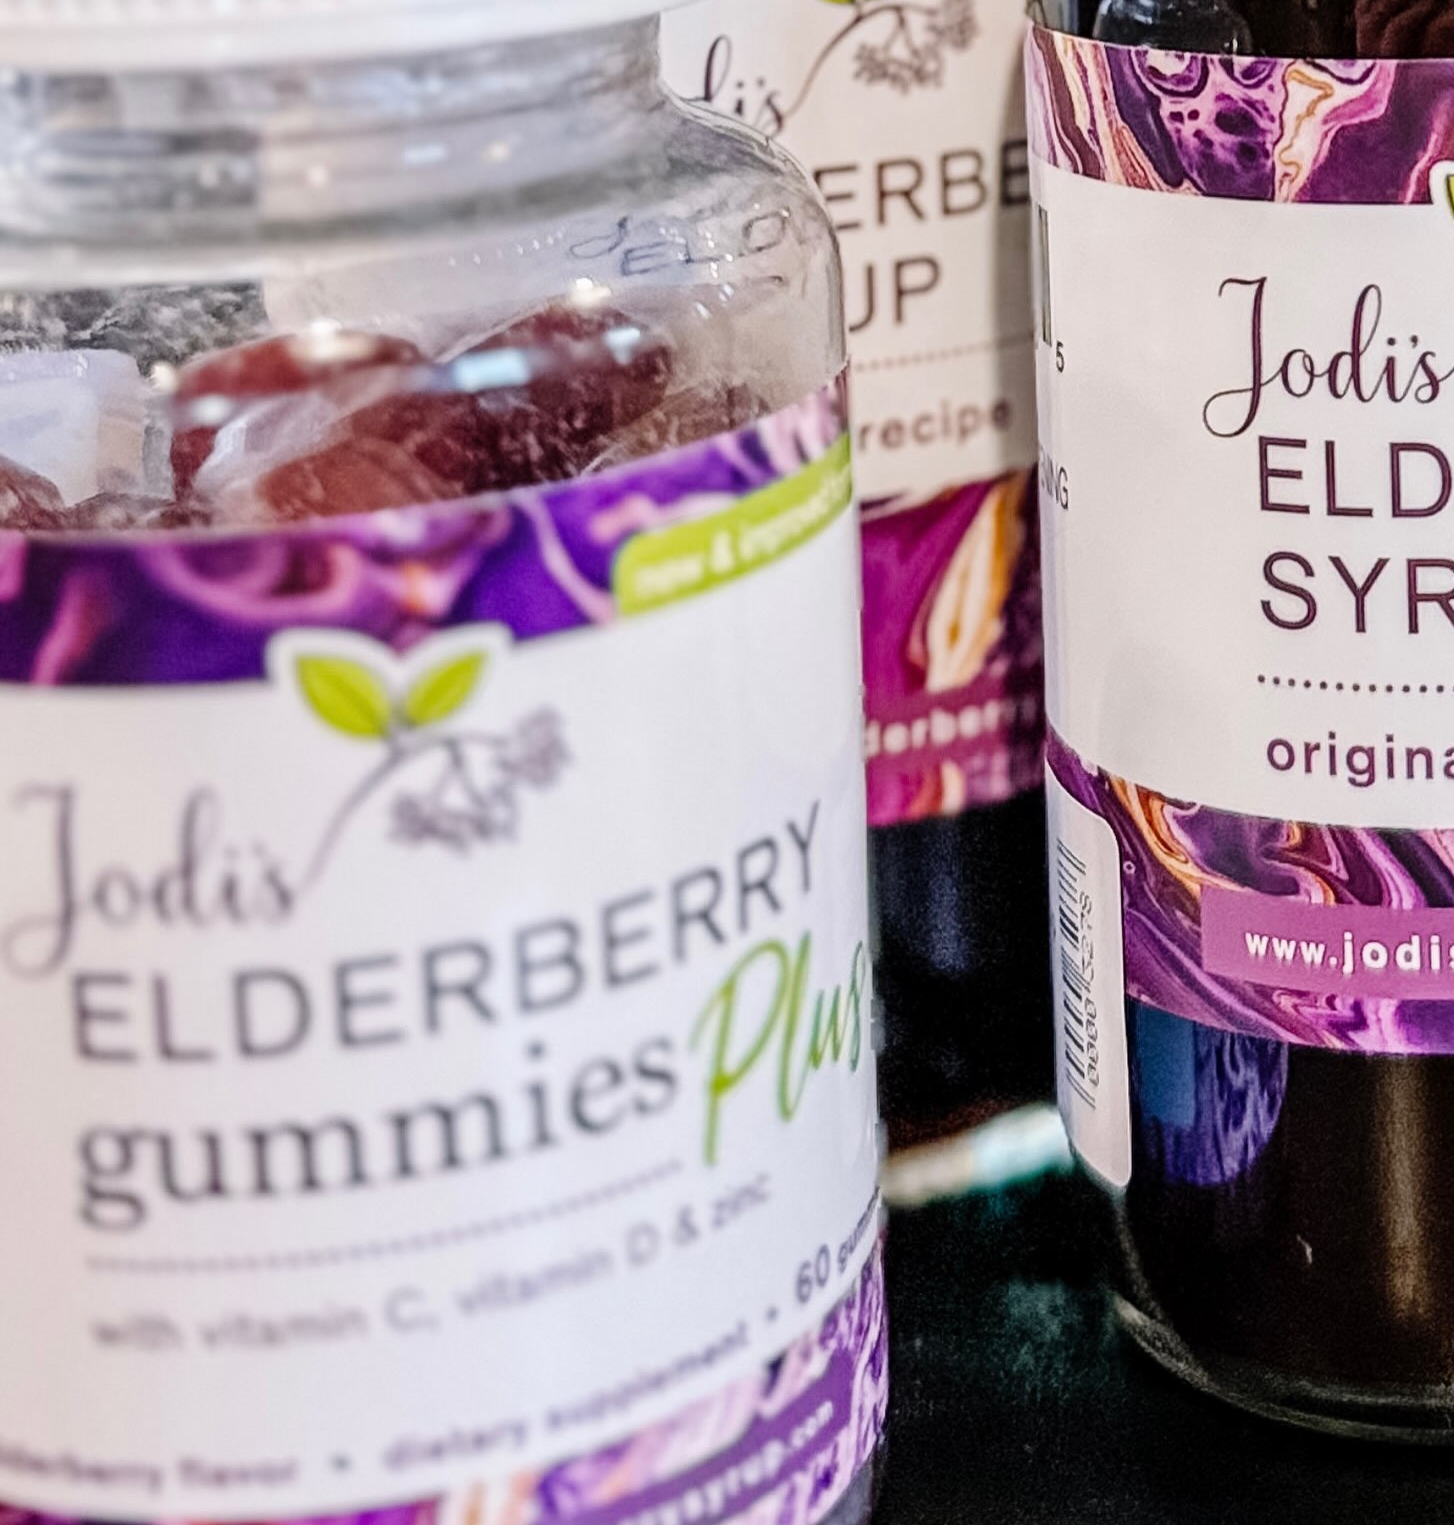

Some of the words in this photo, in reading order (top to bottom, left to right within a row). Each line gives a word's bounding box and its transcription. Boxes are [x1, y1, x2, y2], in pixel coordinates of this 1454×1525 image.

[1203, 276, 1441, 438] Jodi's
[71, 801, 822, 1066] ELDERBERRY
[78, 1038, 678, 1233] gummies
[690, 930, 867, 1168] Plus
[796, 1244, 831, 1305] 60
